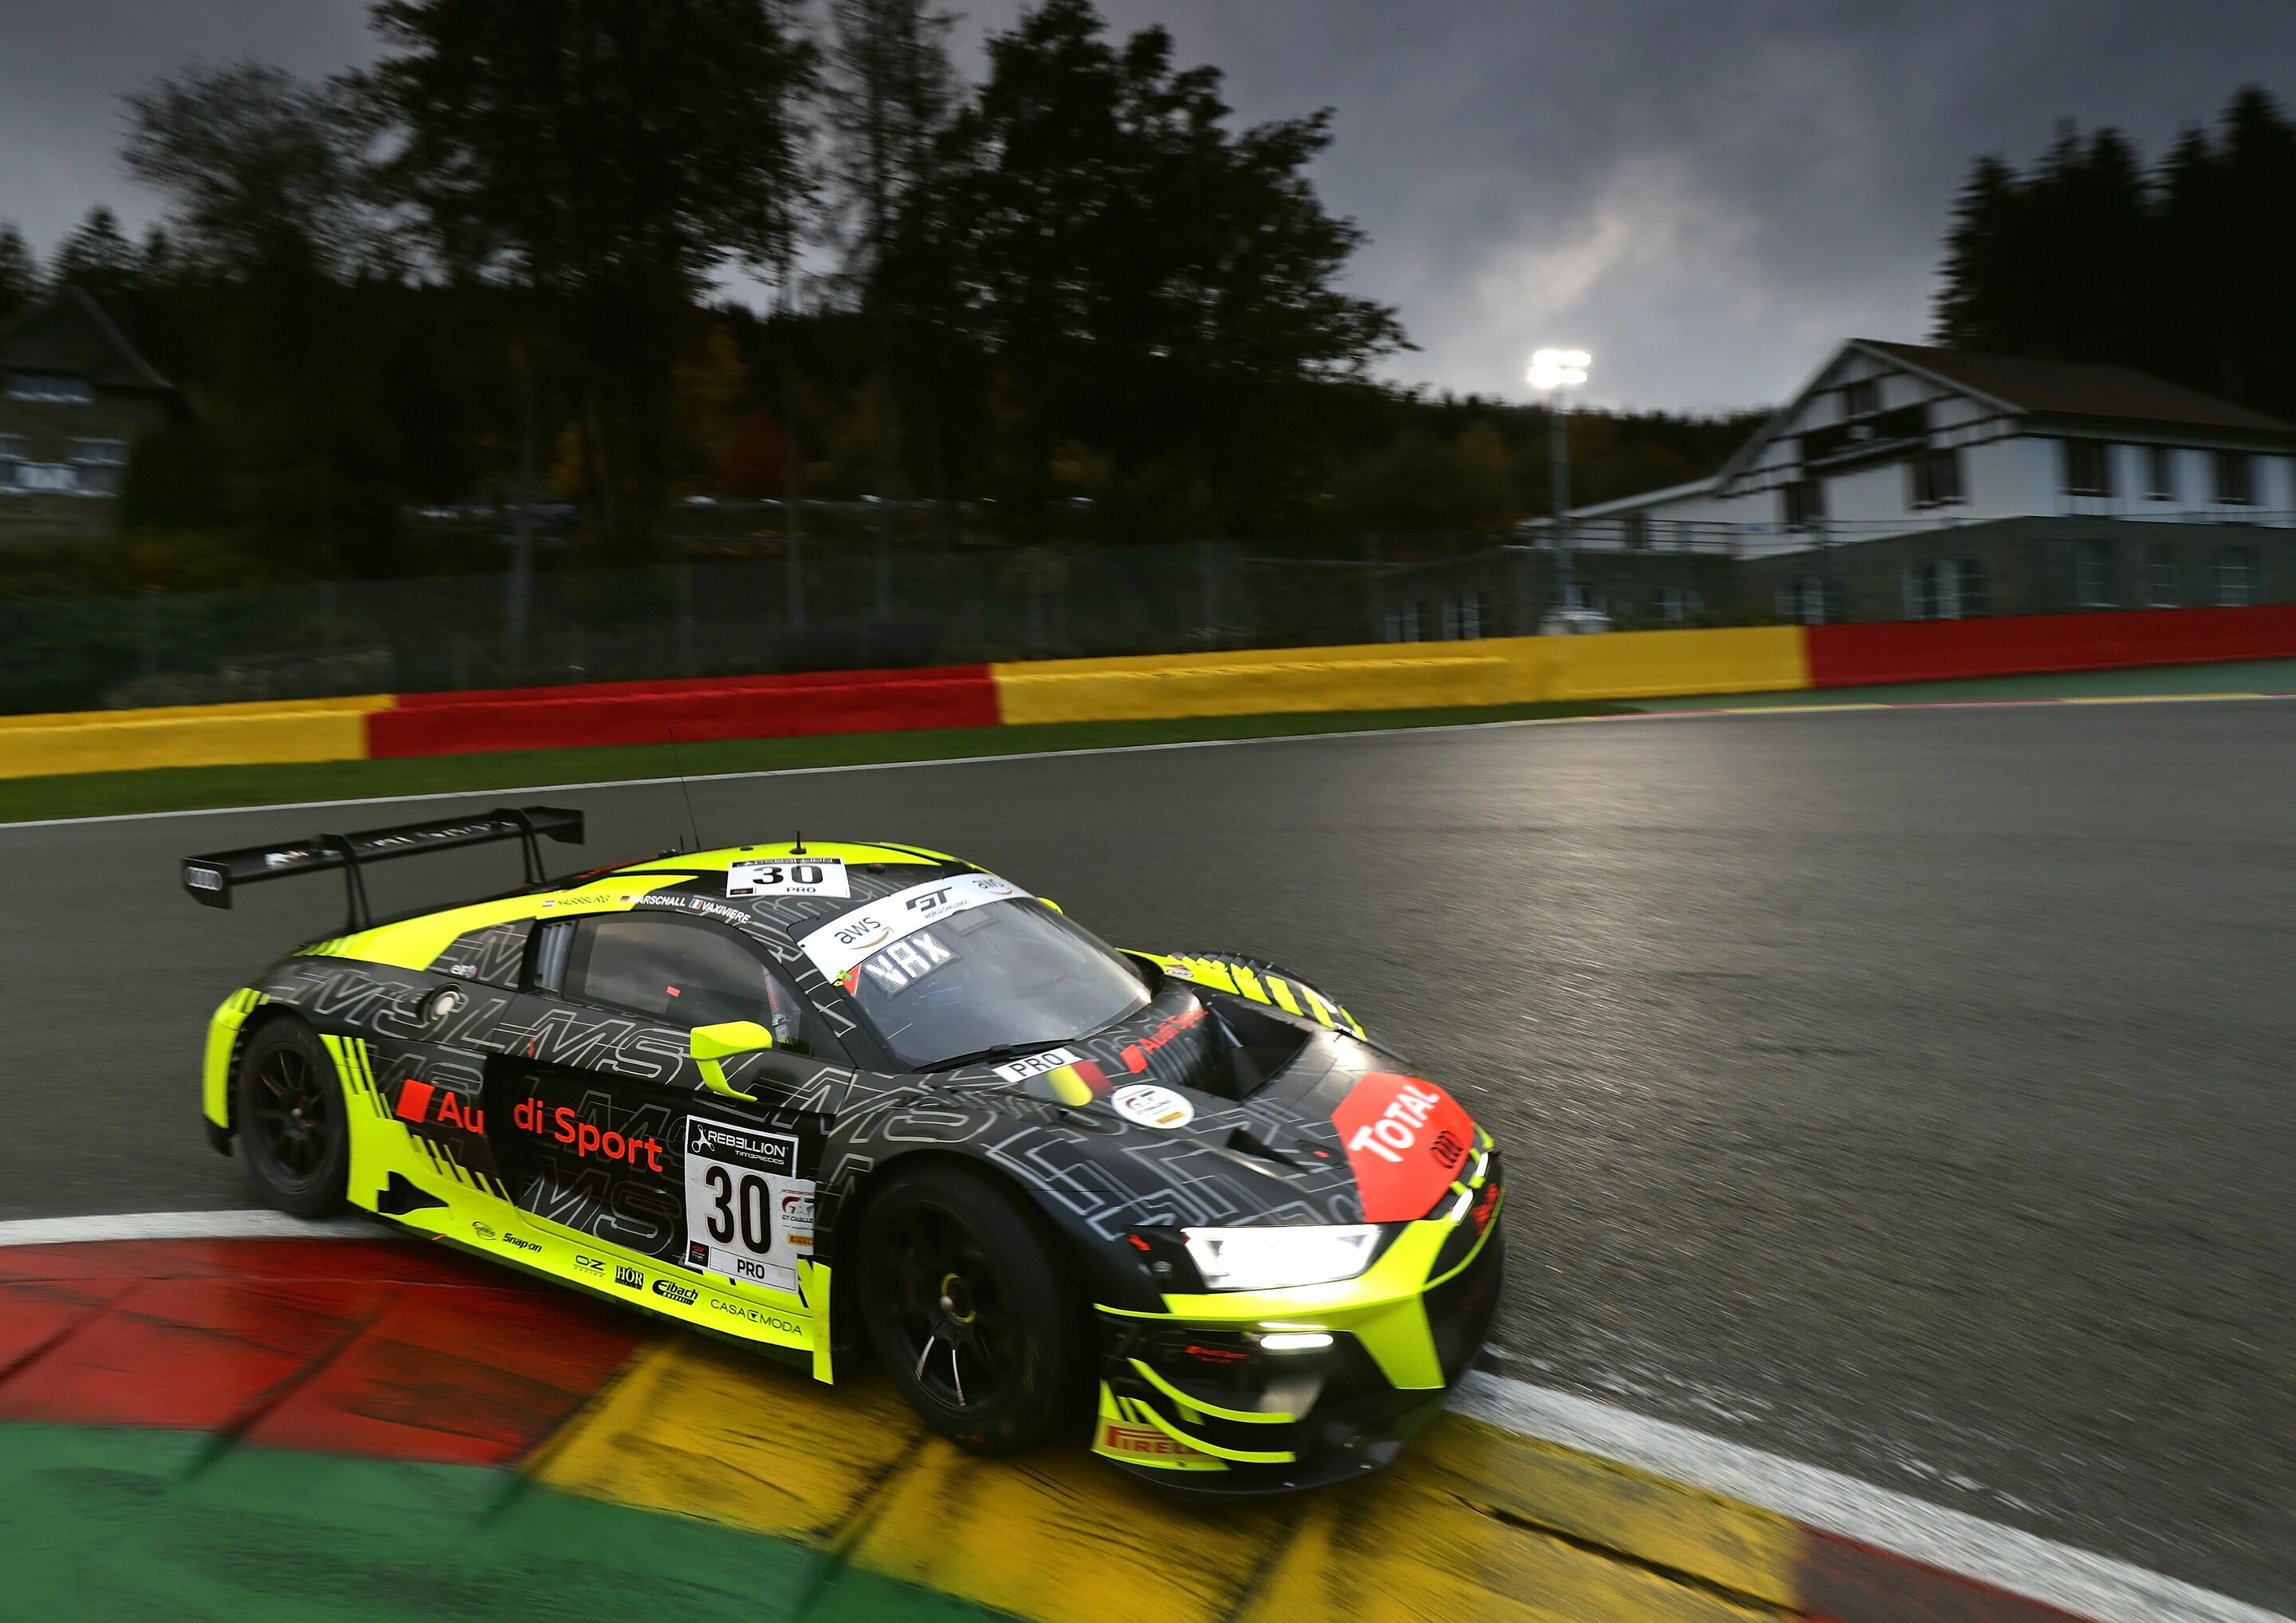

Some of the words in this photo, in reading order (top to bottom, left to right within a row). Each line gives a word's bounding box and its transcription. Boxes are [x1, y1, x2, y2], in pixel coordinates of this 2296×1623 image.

[753, 865, 823, 885] 30
[702, 901, 751, 925] VAXIVIERE
[834, 917, 881, 945] aws
[866, 933, 951, 984] VAX
[1009, 1053, 1065, 1076] PRO
[1347, 1085, 1441, 1162] TOTAL
[554, 1106, 663, 1173] Sport
[707, 1130, 785, 1157] REBELLION
[705, 1163, 772, 1256] 30
[502, 1232, 542, 1252] Snap-on
[737, 1258, 765, 1279] PRO
[652, 1279, 698, 1302] Eibach
[710, 1299, 745, 1317] CASA
[760, 1314, 803, 1336] MODA
